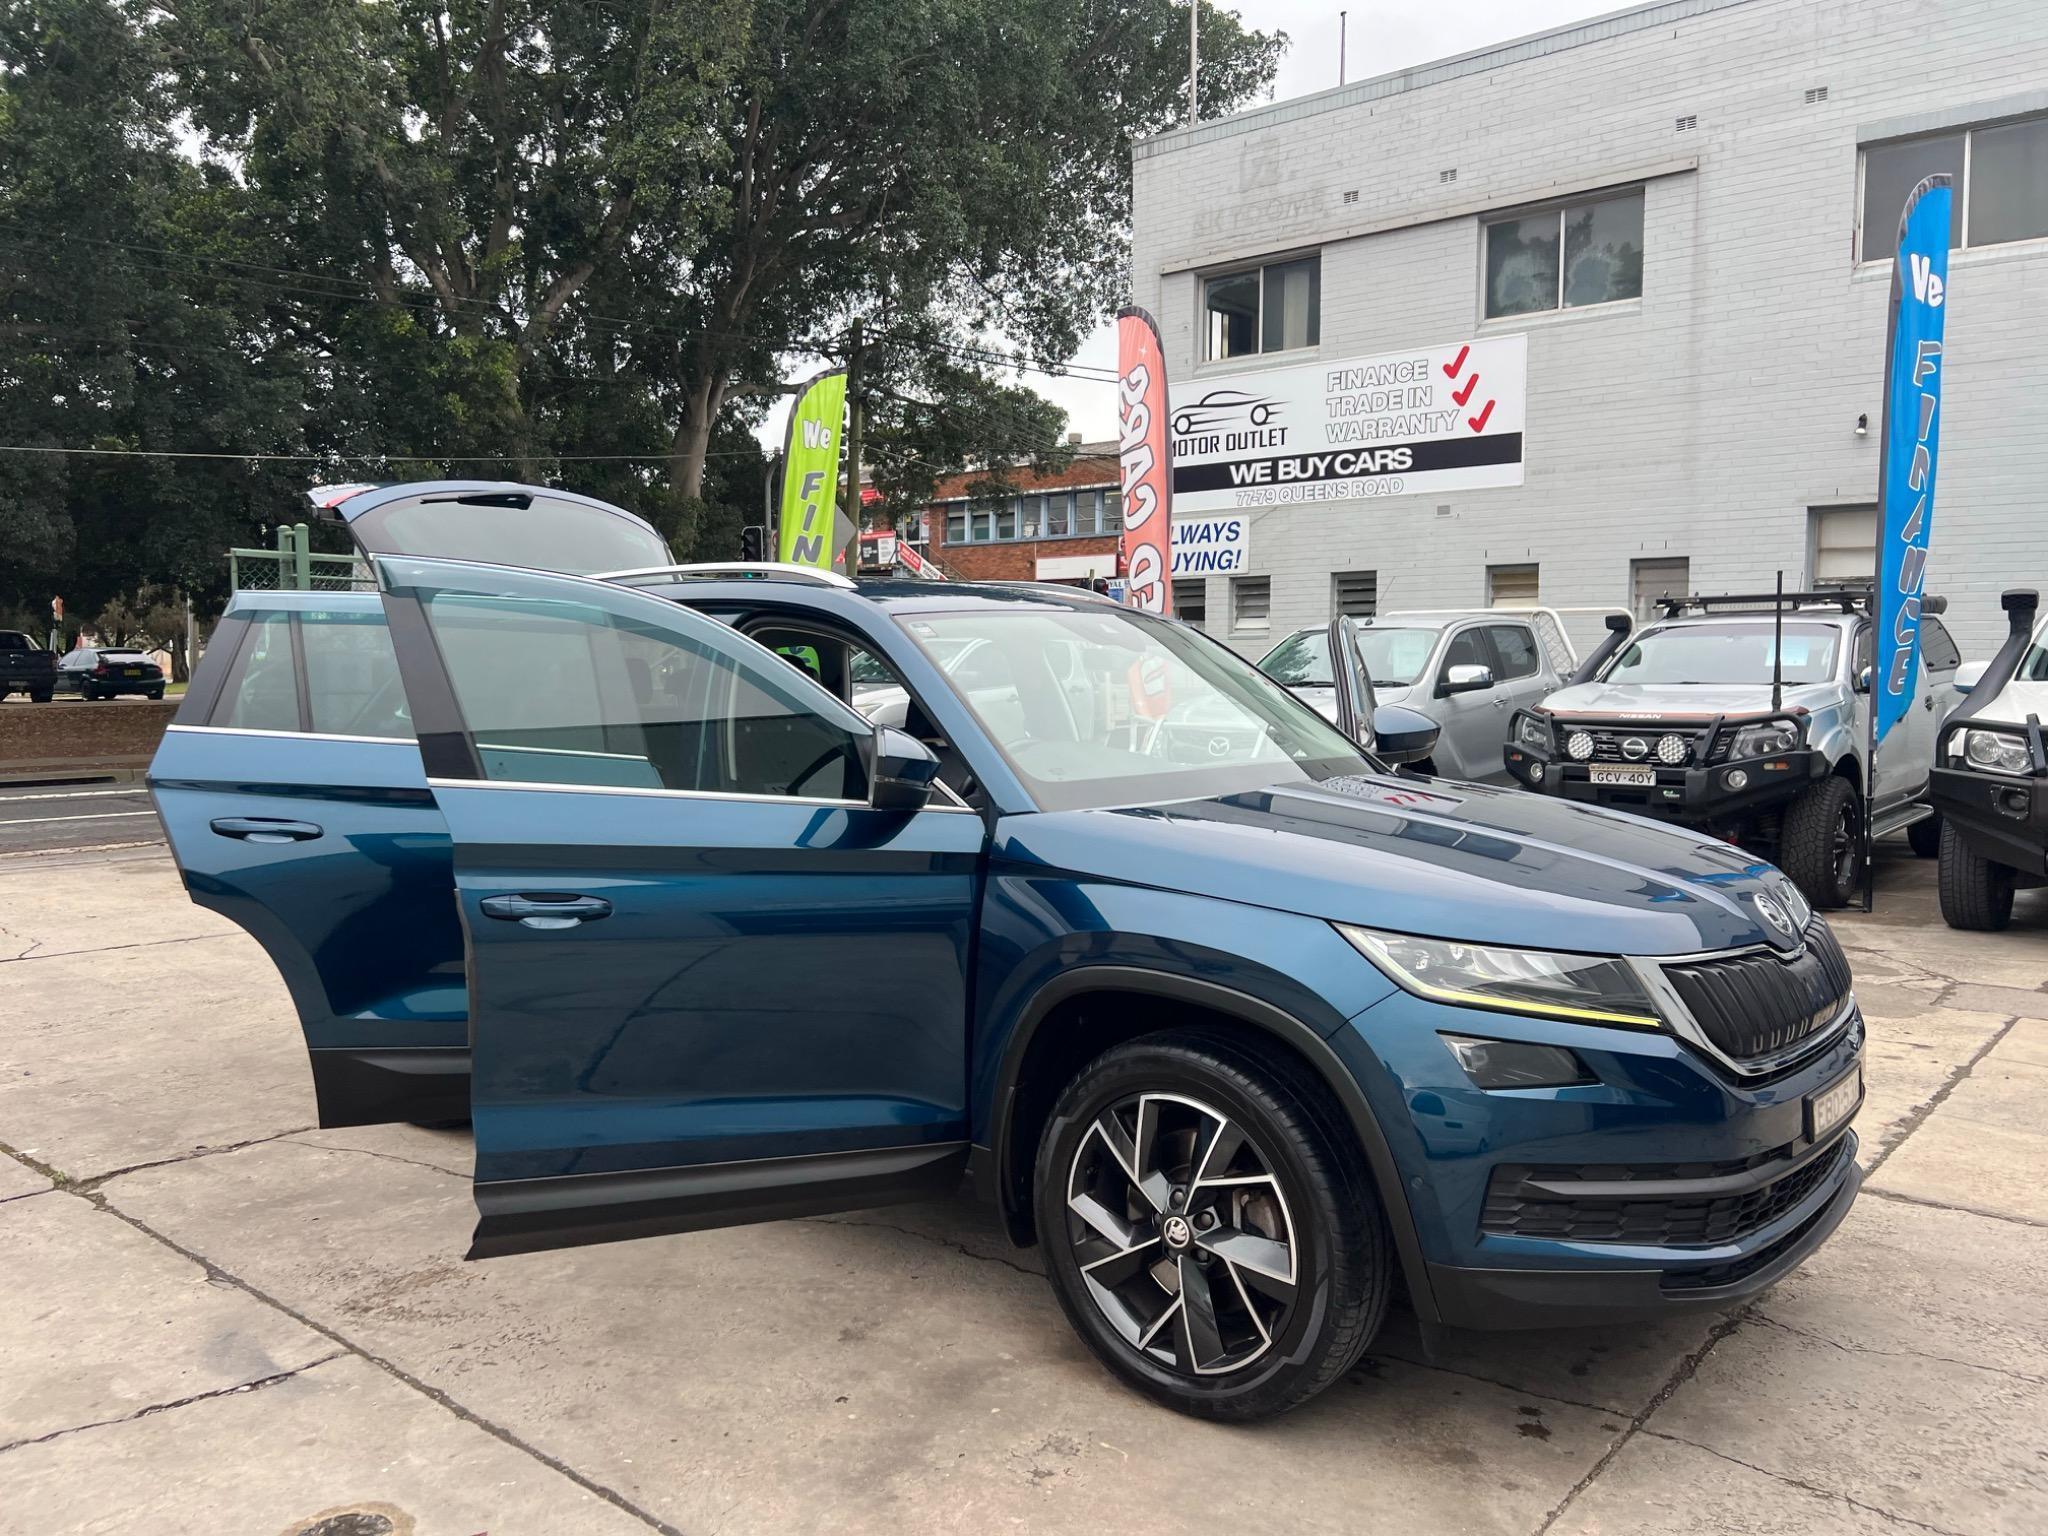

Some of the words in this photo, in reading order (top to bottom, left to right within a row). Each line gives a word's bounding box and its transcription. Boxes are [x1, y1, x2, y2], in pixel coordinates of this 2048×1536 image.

[1326, 359, 1429, 392] FINANCE
[1326, 389, 1403, 418] TRADE
[1407, 385, 1432, 409] IN
[802, 418, 832, 450] We
[1226, 427, 1288, 452] OUTLET
[1325, 408, 1460, 443] WARRANTY
[1229, 461, 1272, 485] WE
[1278, 454, 1334, 481] BUY
[1334, 447, 1413, 475] CARS
[1236, 487, 1276, 506] 77-79
[1279, 481, 1349, 503] QUEENS
[1351, 477, 1404, 497] ROAD
[1171, 520, 1241, 545] LWAYS
[1171, 549, 1242, 573] UYING!
[1618, 712, 1662, 720] NISSAN
